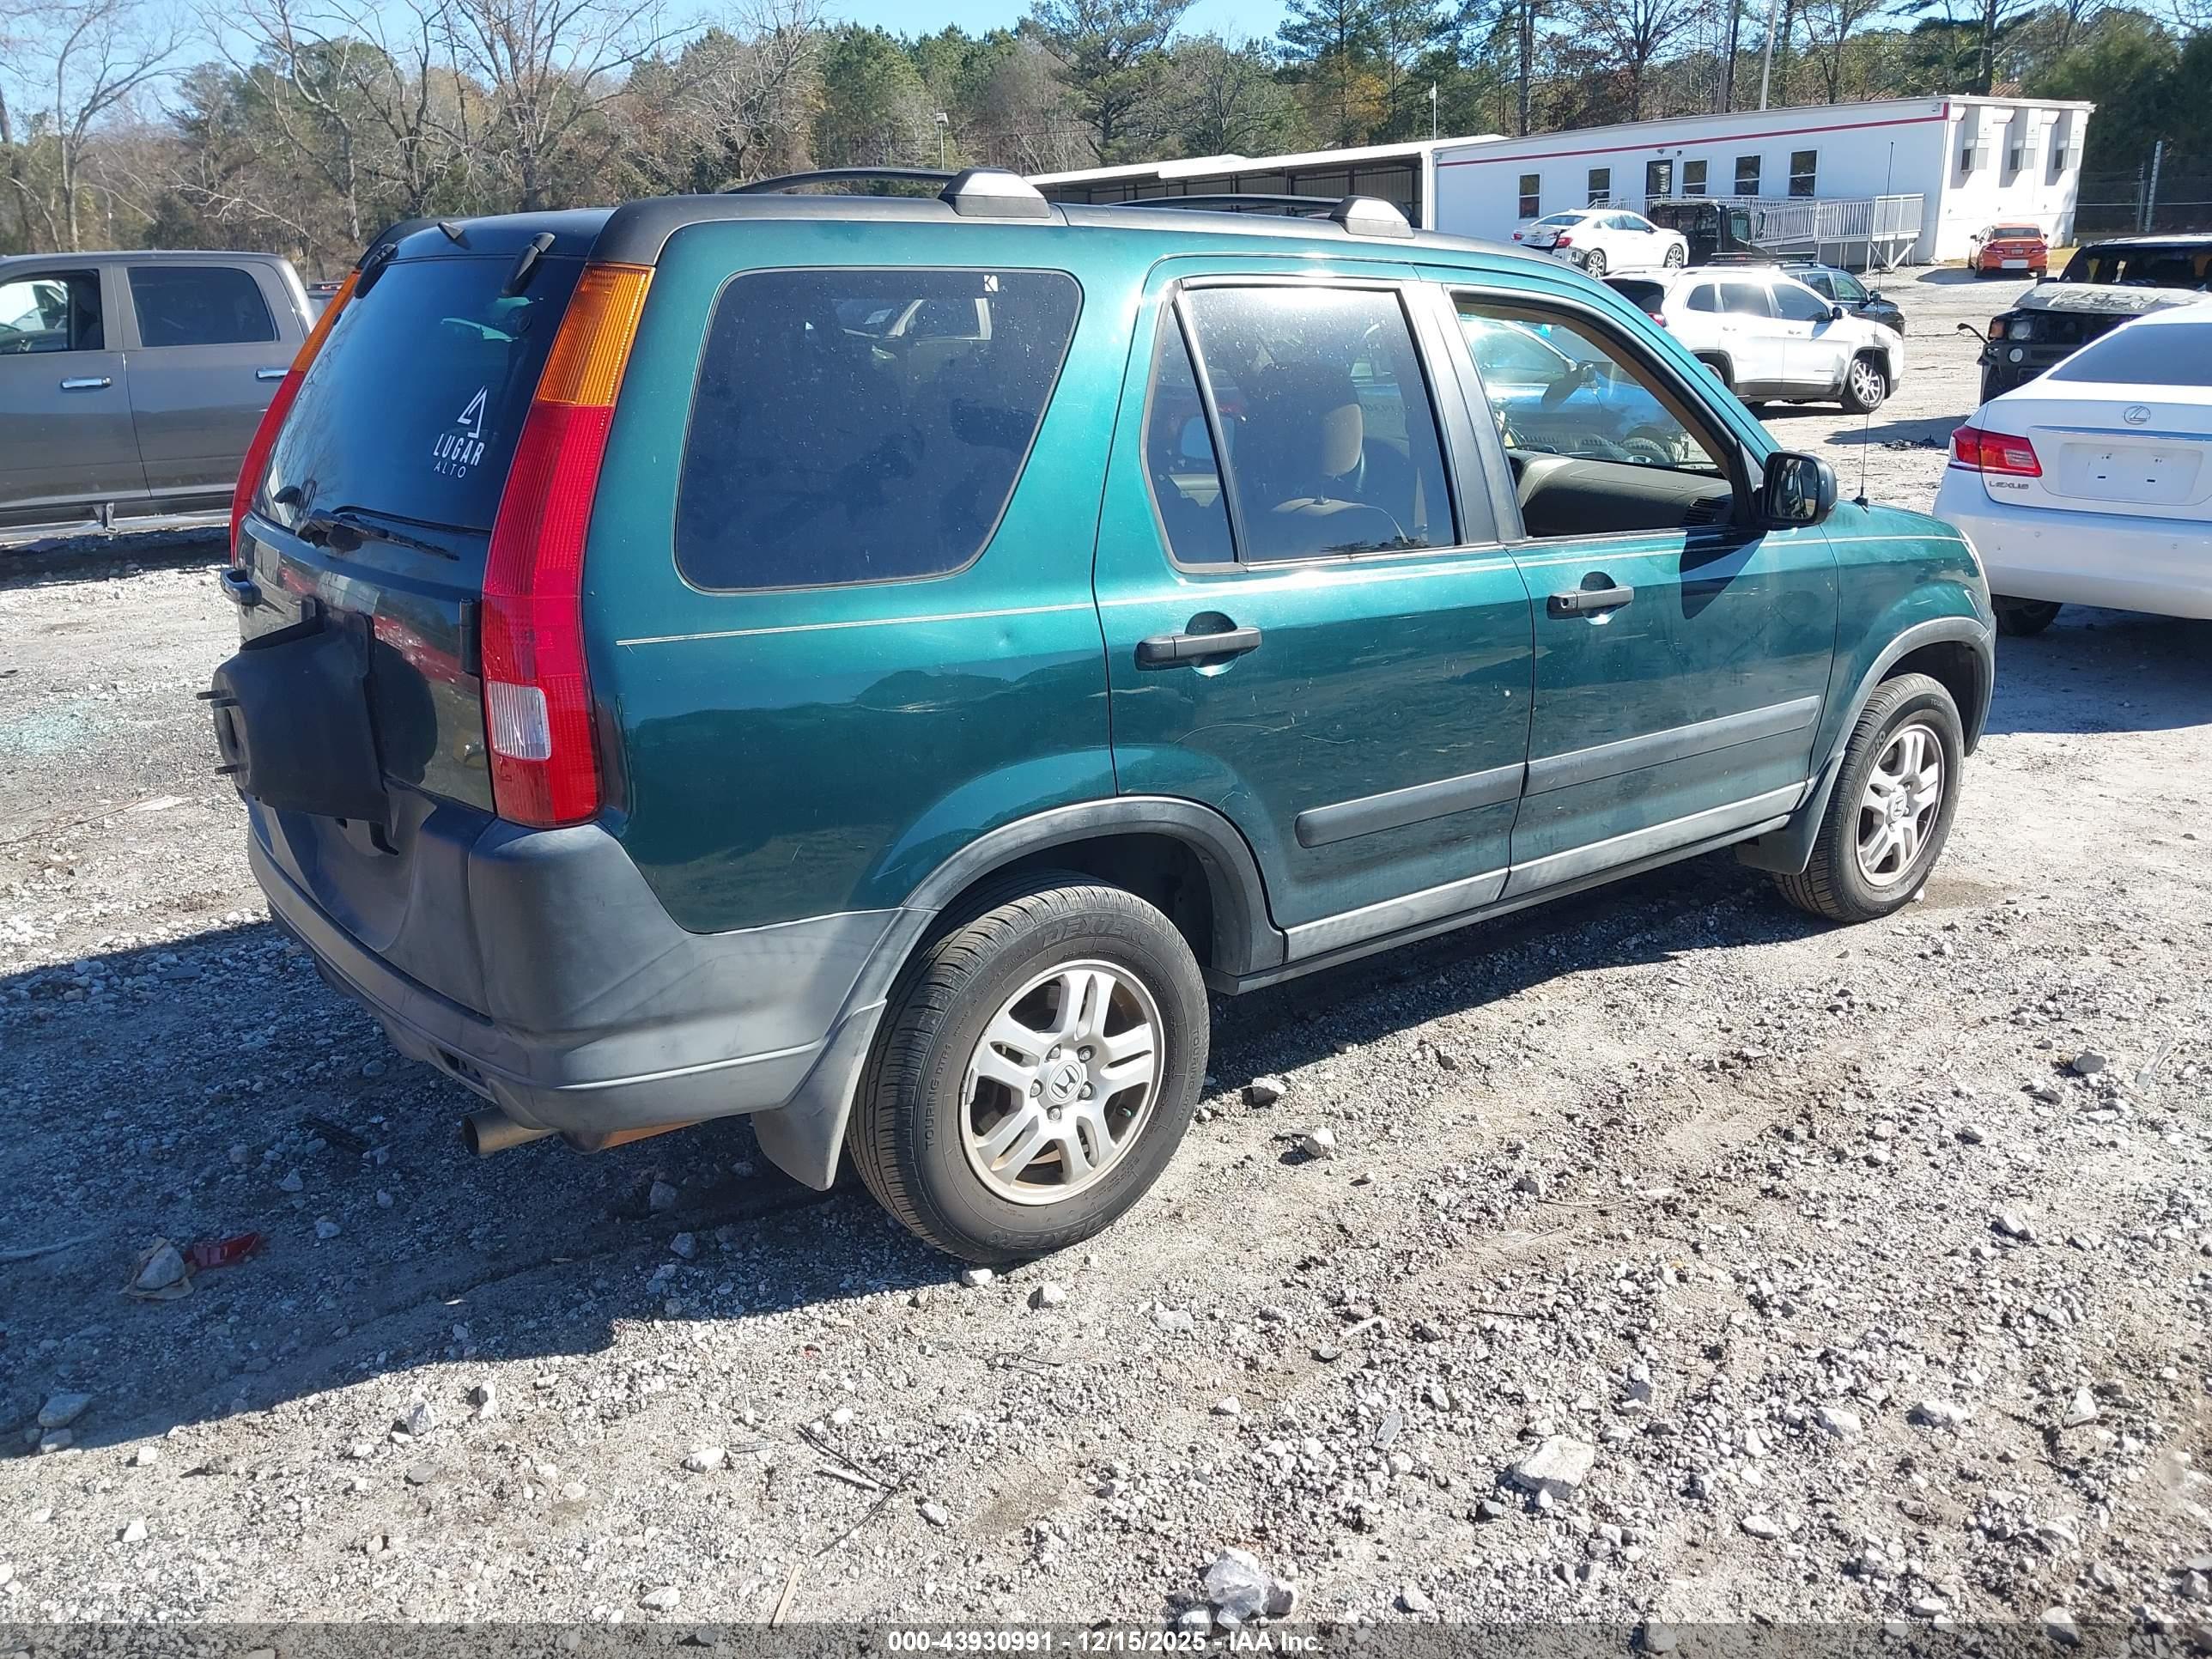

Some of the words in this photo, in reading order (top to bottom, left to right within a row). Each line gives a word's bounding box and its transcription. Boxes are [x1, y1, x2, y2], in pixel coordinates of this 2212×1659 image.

[433, 433, 485, 466] LUGAR
[433, 460, 467, 478] ALTO
[1988, 480, 2030, 490] LEXUS
[925, 1079, 940, 1151] TOURING
